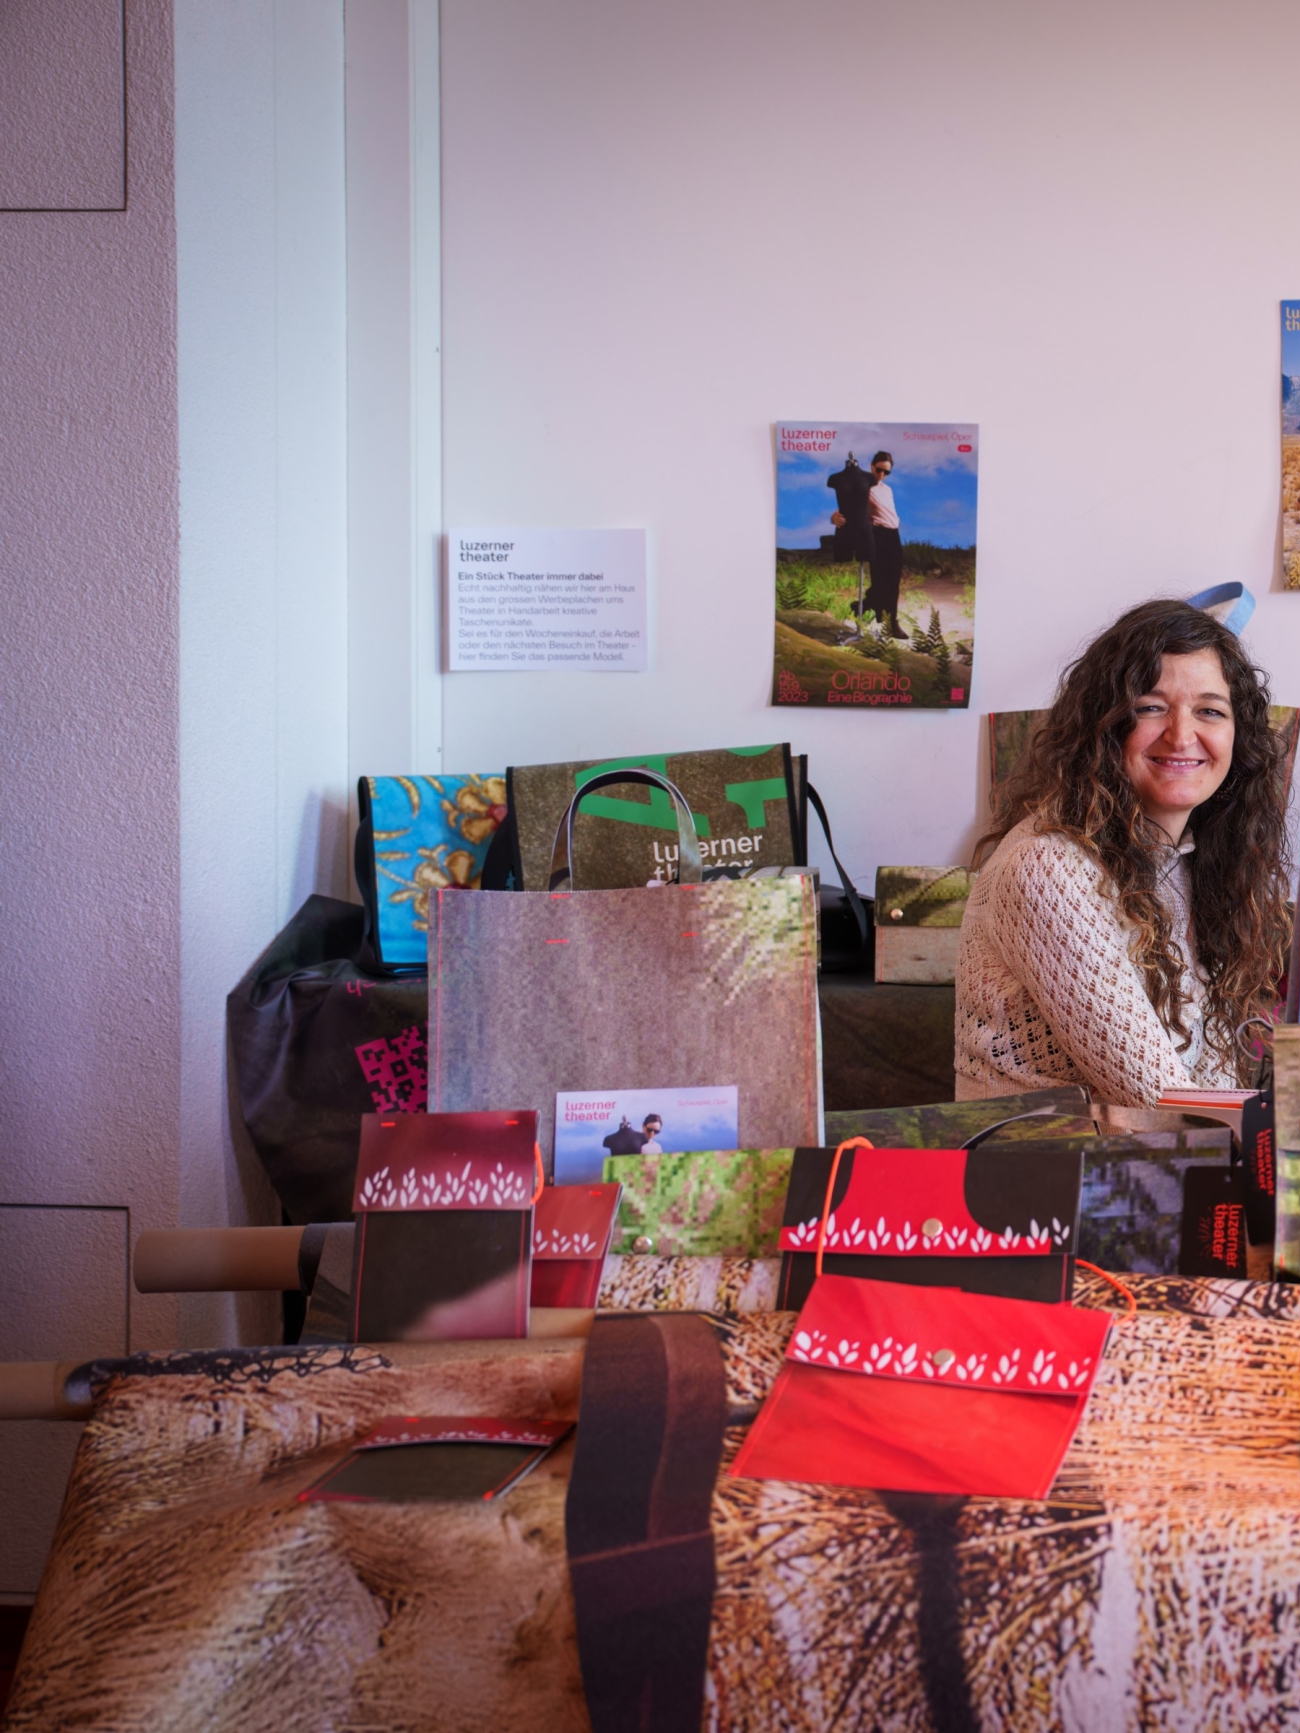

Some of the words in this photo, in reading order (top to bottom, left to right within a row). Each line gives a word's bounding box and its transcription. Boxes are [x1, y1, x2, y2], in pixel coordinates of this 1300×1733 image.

[781, 427, 837, 439] luzerner
[951, 431, 972, 441] Oper
[781, 439, 831, 451] theater
[460, 539, 515, 550] luzerner
[460, 551, 509, 562] theater
[458, 571, 474, 581] Ein
[476, 571, 505, 581] Stück
[507, 571, 545, 581] Theater
[546, 572, 576, 581] immer
[578, 571, 604, 581] dabei
[458, 583, 480, 592] Echt
[483, 583, 532, 594] nachhaltig
[565, 584, 579, 592] wir
[580, 583, 597, 592] hier
[615, 583, 636, 592] Haus
[458, 596, 476, 604] aus
[477, 595, 496, 604] den
[498, 596, 536, 606] grossen
[459, 606, 495, 615] Theater
[497, 606, 506, 615] in
[508, 606, 560, 615] Handarbeit
[562, 606, 598, 615] kreative
[458, 629, 474, 638] Sei
[490, 629, 502, 638] für
[505, 629, 523, 638] den
[599, 630, 613, 639] die
[614, 630, 640, 639] Arbeit
[458, 641, 481, 650] oder
[483, 641, 502, 650] den
[504, 641, 547, 650] nächsten
[548, 640, 582, 650] Besuch
[584, 641, 595, 650] im
[597, 640, 630, 650] Theater
[458, 652, 476, 661] hier
[478, 652, 509, 661] finden
[511, 652, 526, 661] Sie
[528, 652, 545, 661] das
[547, 653, 591, 663] passende
[832, 670, 911, 691] Orlando
[777, 690, 809, 702] 2023
[827, 691, 852, 703] Eine
[853, 691, 912, 705] Biographie
[653, 834, 763, 863] luerner
[566, 1100, 617, 1111] luzerner
[565, 1111, 611, 1122] theater
[1256, 1131, 1267, 1190] theater
[1264, 1128, 1275, 1196] luzerner
[1212, 1203, 1228, 1260] theater
[1226, 1203, 1243, 1268] luzerner
